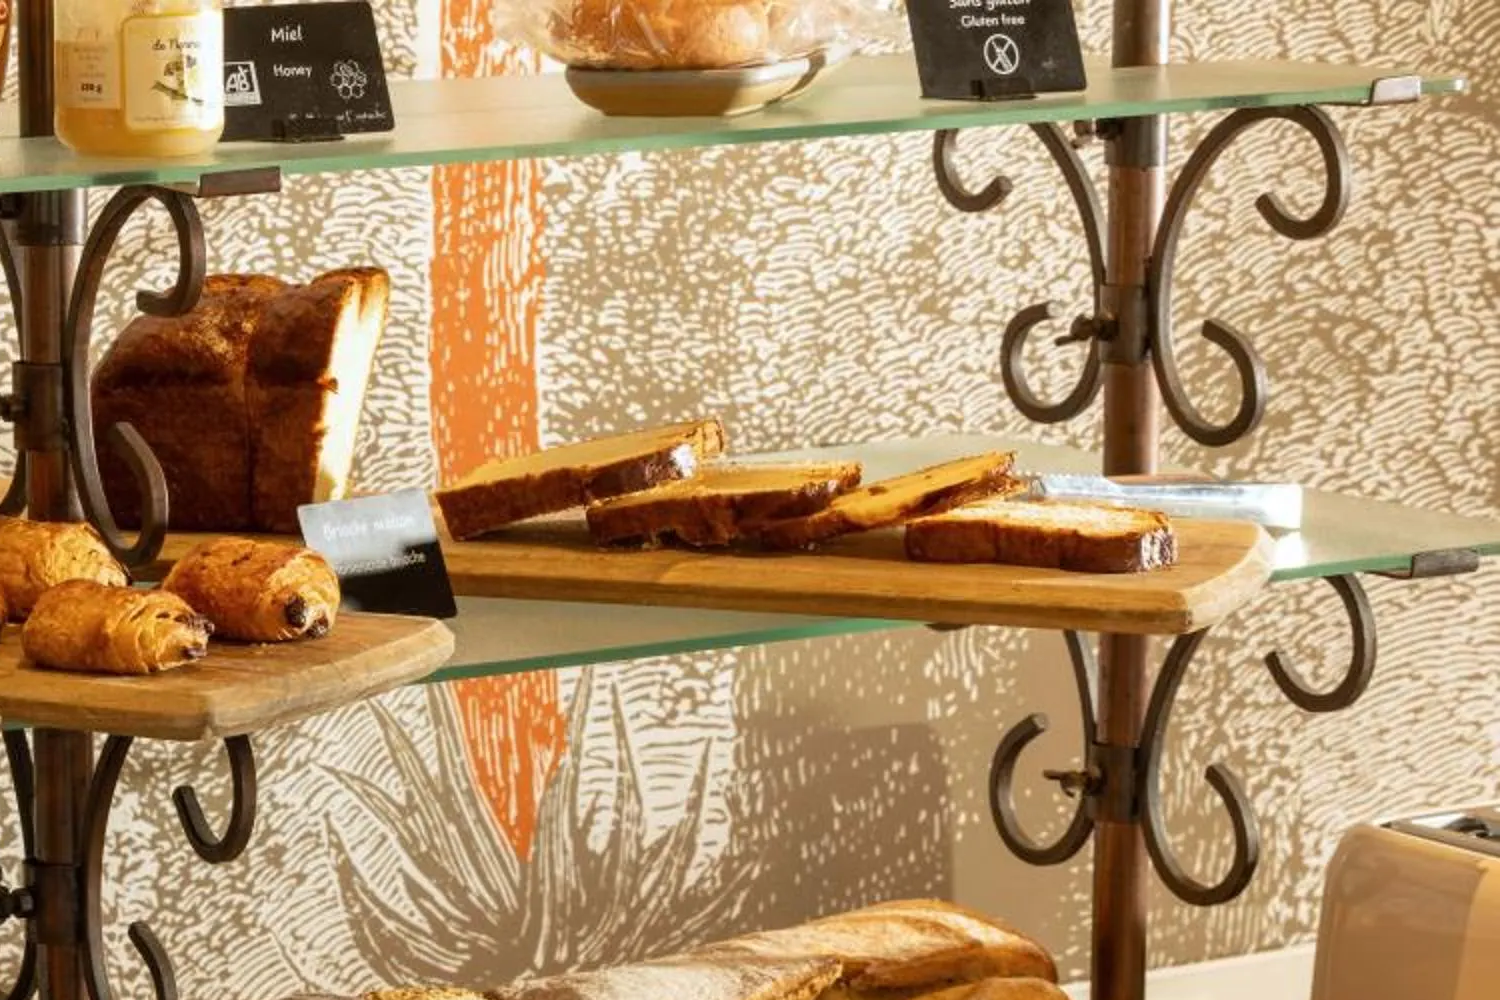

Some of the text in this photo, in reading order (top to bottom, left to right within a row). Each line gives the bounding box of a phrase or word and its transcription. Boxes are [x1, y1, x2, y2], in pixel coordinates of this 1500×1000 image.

[961, 13, 1025, 28] Gluten free
[271, 25, 303, 43] Miel
[273, 64, 312, 78] Honey
